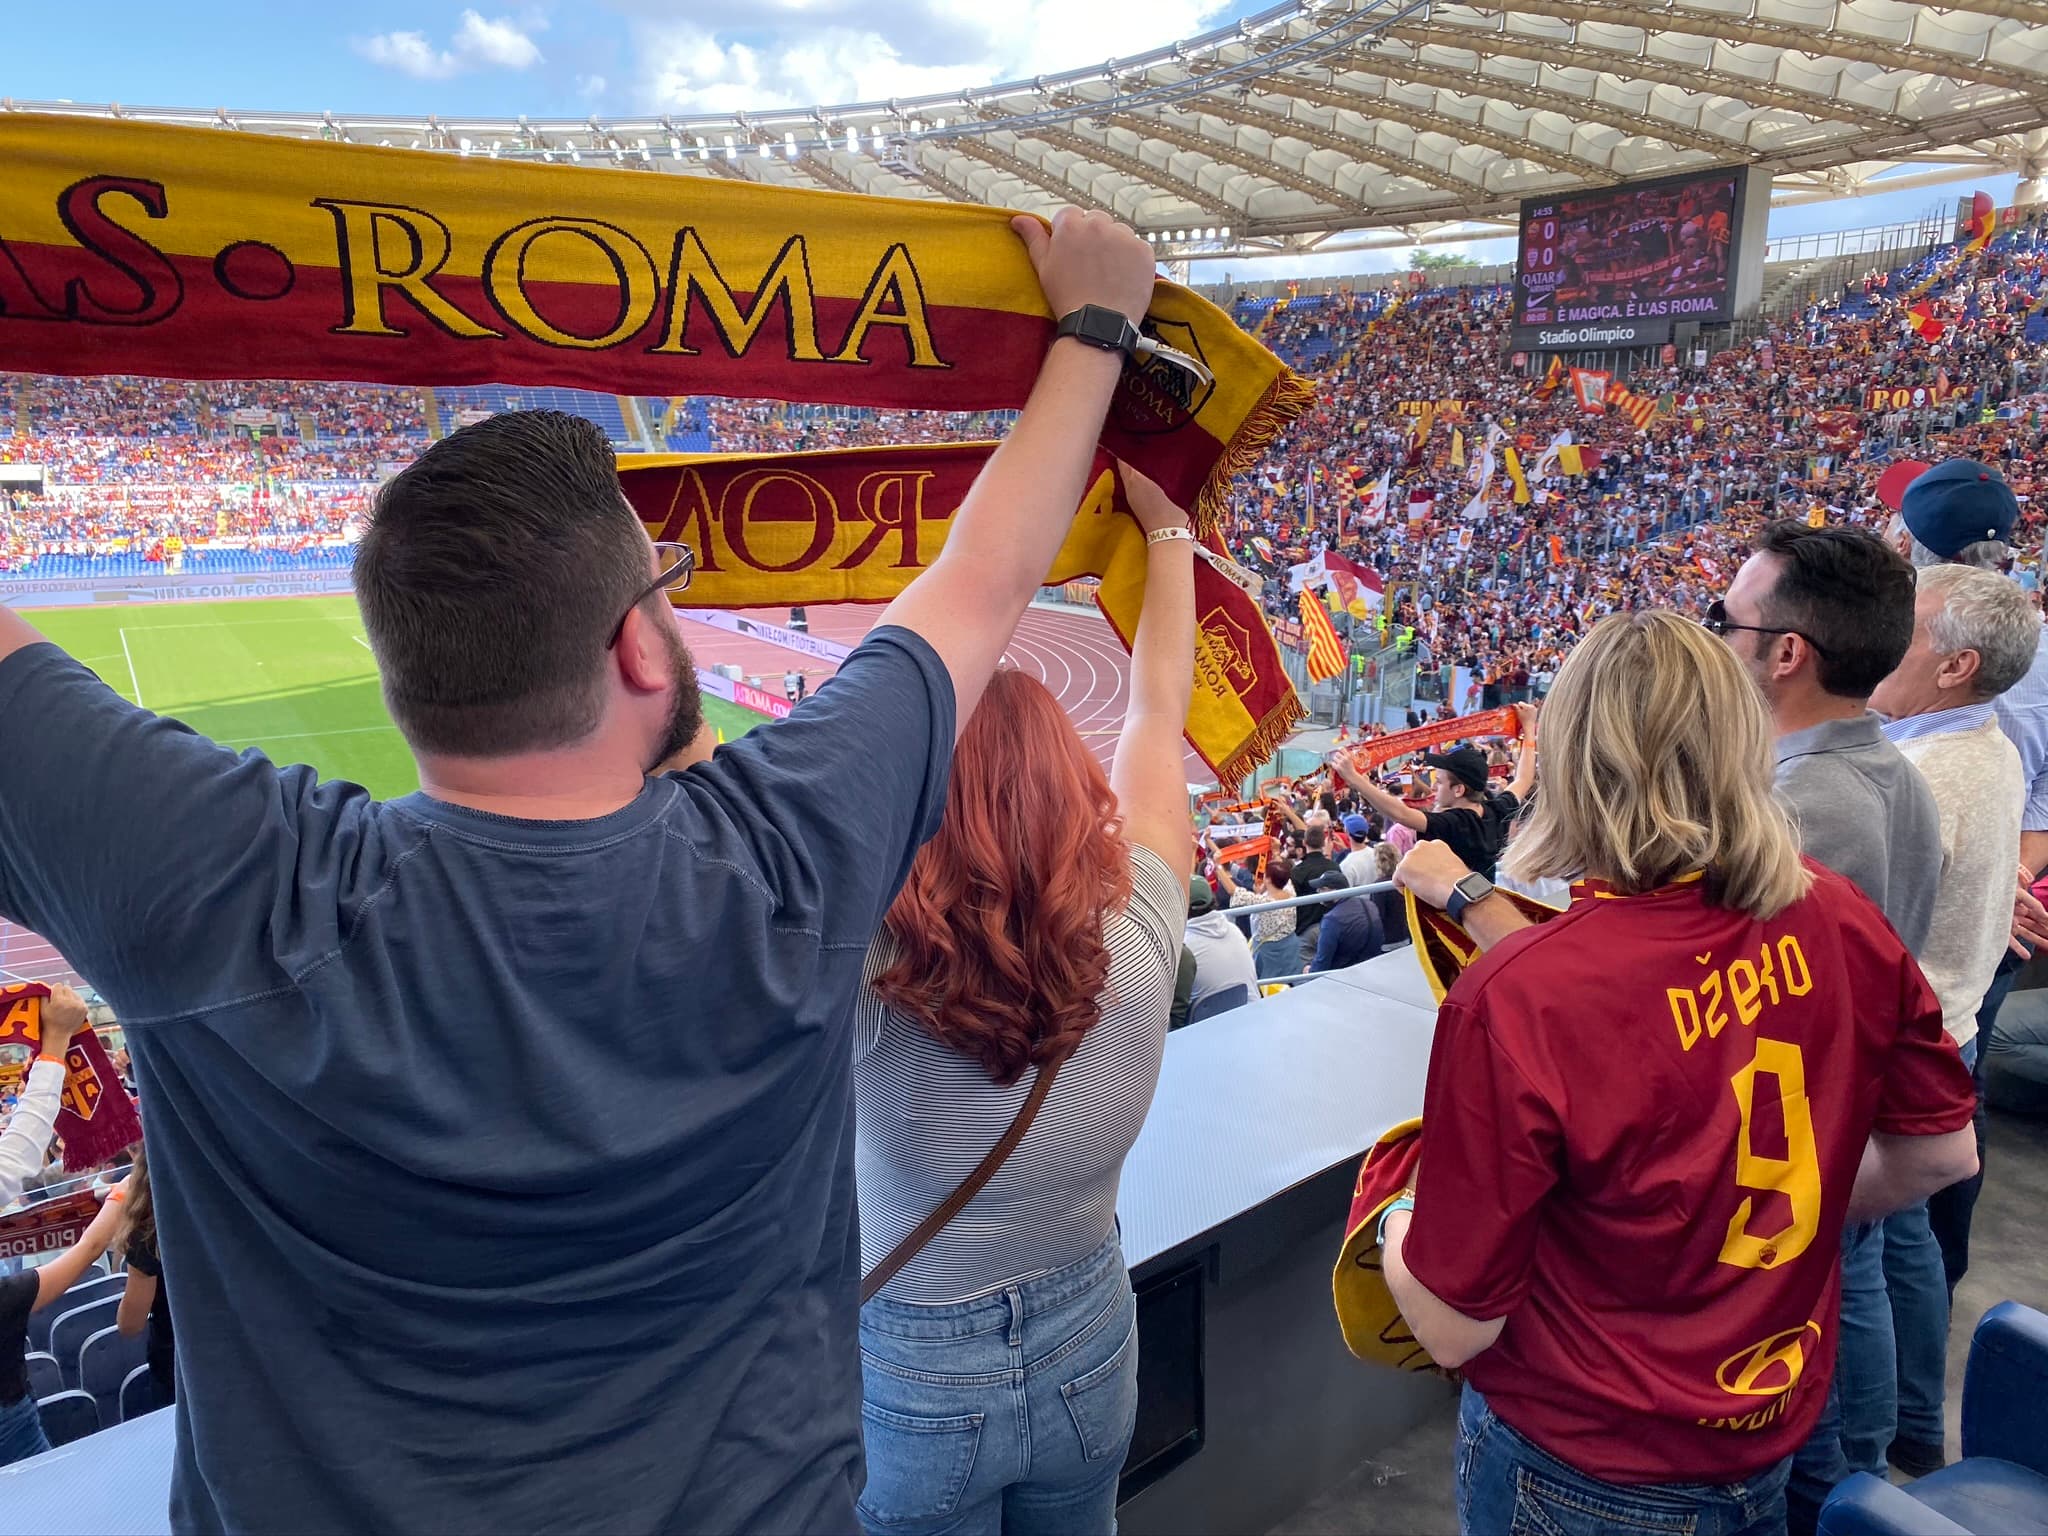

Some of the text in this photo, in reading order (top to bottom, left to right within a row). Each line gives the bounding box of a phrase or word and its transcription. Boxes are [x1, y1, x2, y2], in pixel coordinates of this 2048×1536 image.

[1544, 221, 1555, 240] 0
[1543, 247, 1553, 266] 0
[310, 197, 954, 369] ROMA
[1522, 271, 1555, 288] QATAR
[1568, 304, 1623, 322] MAGICA.
[1638, 300, 1668, 316] L'AS
[1671, 297, 1719, 314] ROMA.
[1539, 325, 1635, 345] Stadio Olimpico
[1212, 557, 1243, 586] ROMA
[1718, 1037, 1822, 1270] 9
